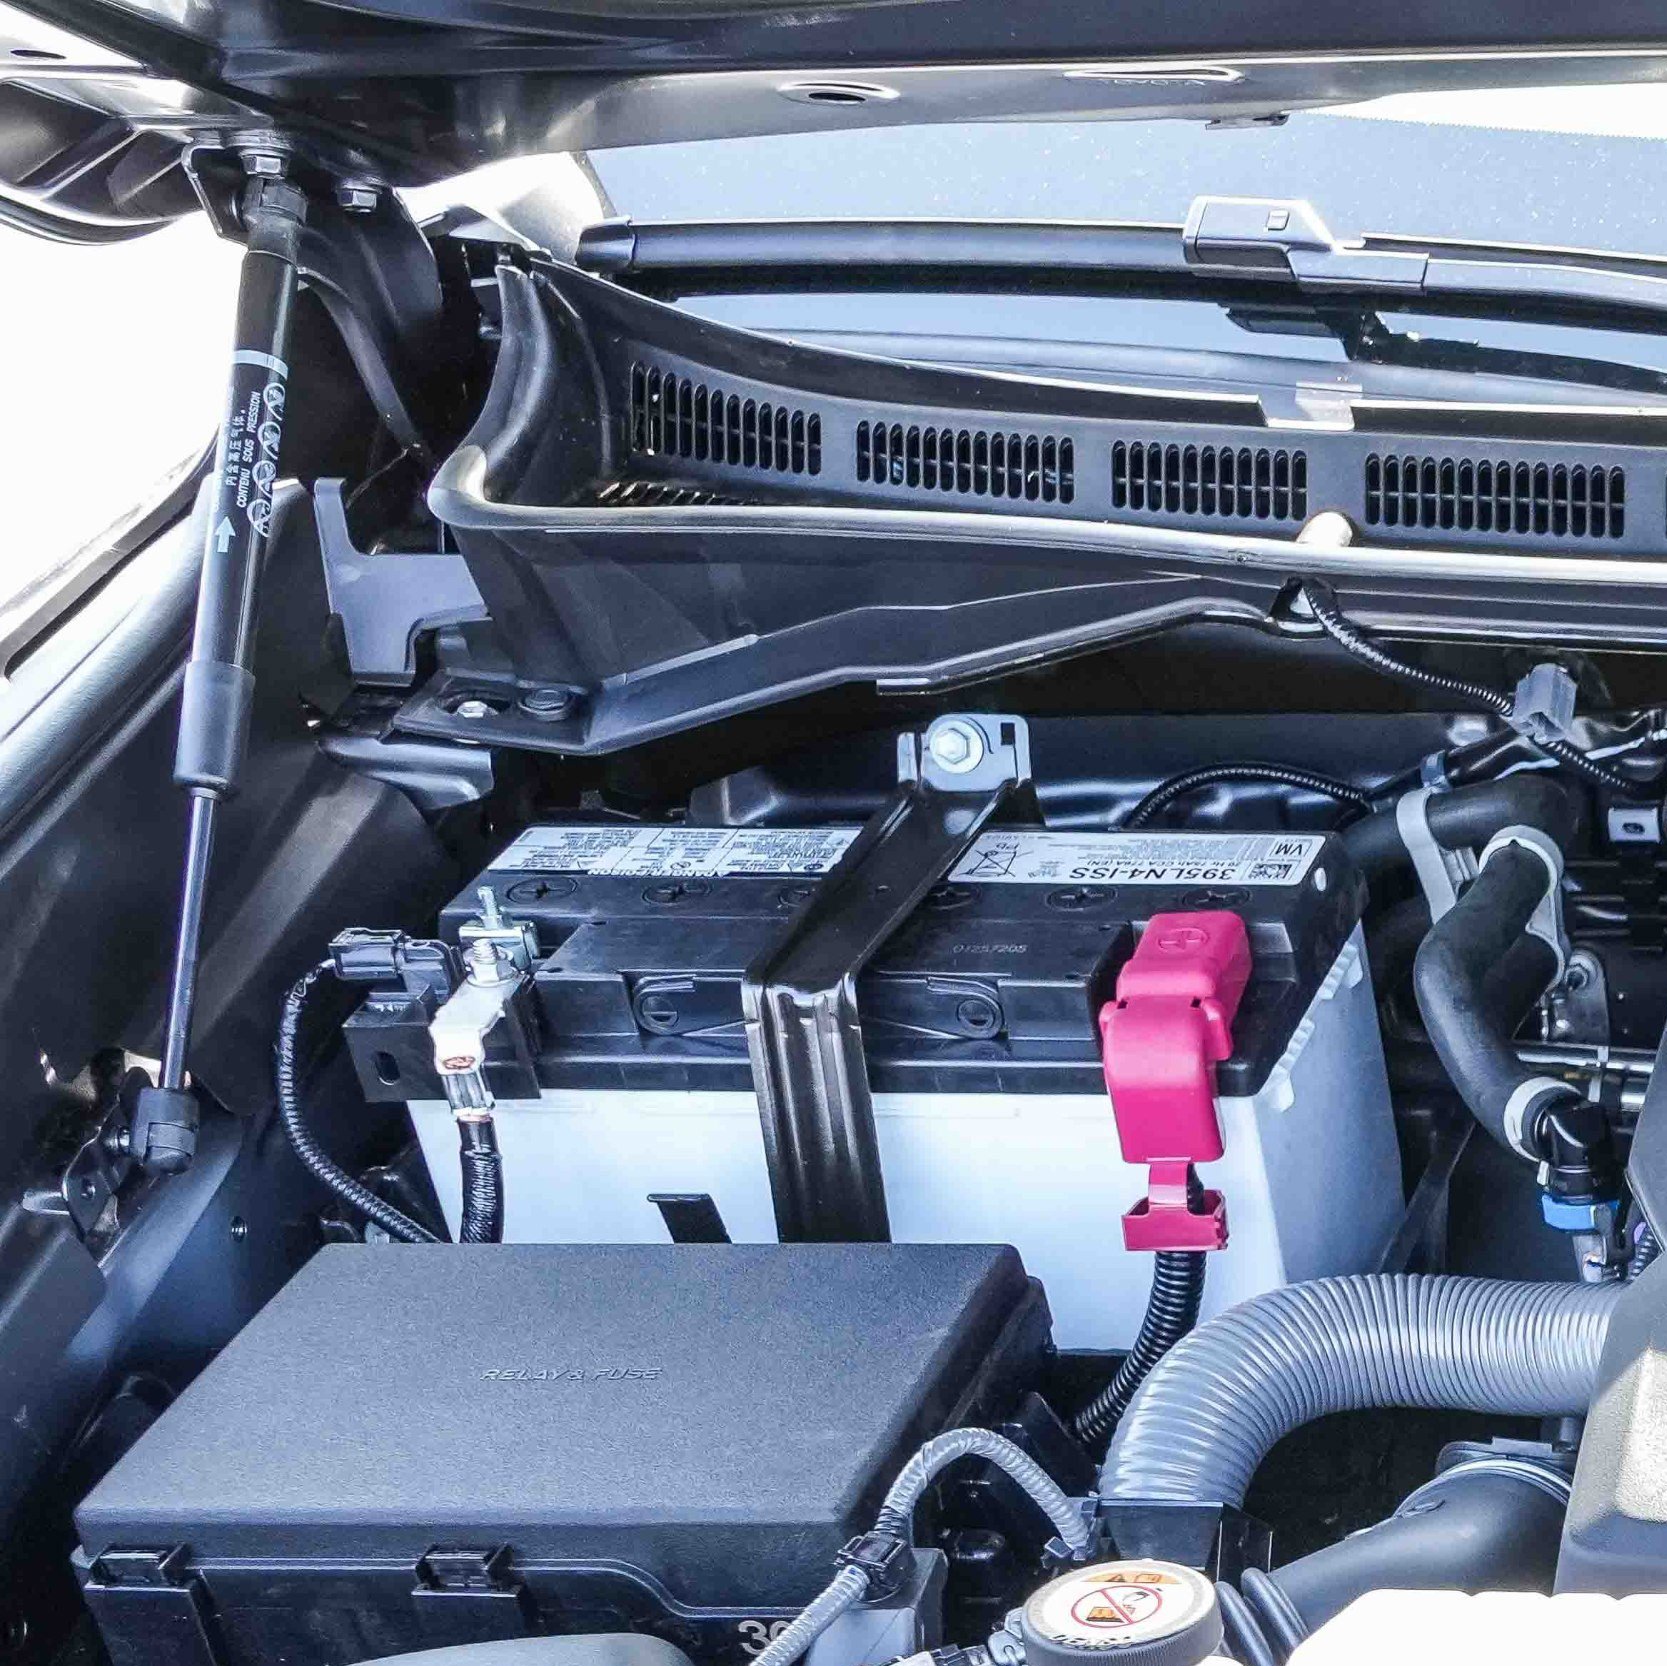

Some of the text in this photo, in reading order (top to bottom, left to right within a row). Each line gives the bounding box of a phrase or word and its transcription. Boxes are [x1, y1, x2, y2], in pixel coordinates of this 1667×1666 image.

[236, 391, 261, 508] CONTENU SOUS PRESSION
[1275, 844, 1303, 856] VM
[1069, 868, 1236, 880] 395LN4-ISS
[591, 1367, 663, 1381] FUSE
